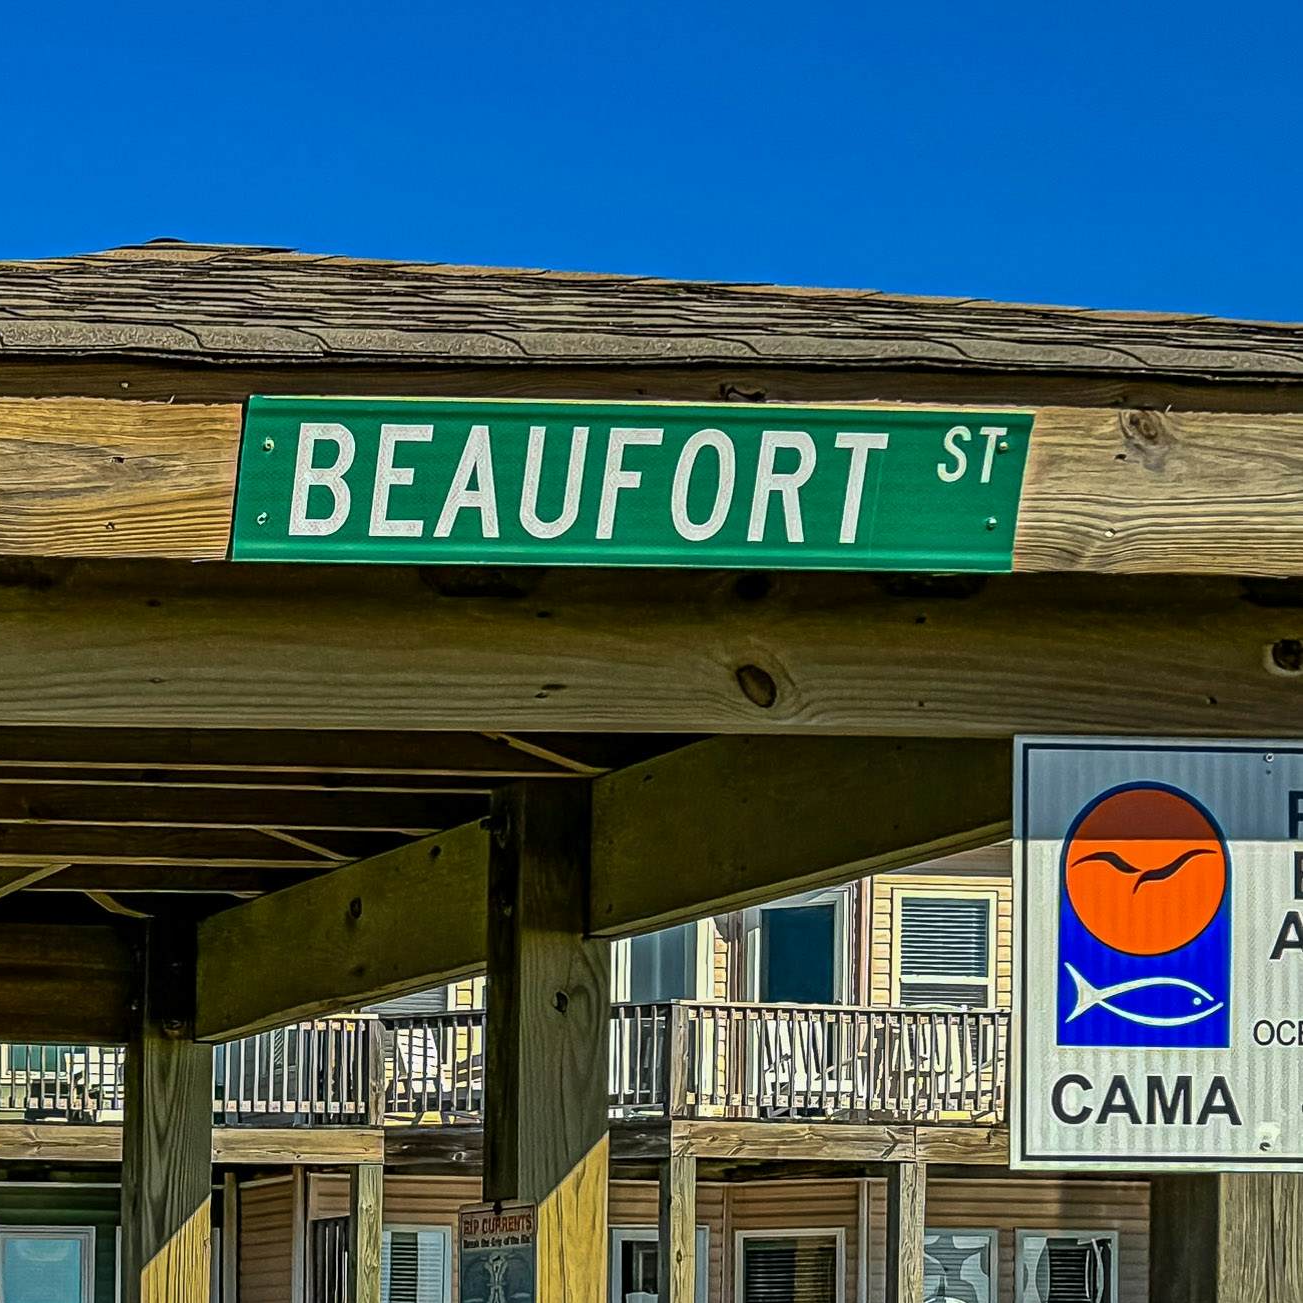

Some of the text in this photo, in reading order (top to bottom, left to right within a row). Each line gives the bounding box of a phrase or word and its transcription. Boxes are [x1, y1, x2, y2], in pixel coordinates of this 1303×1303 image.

[288, 422, 1008, 544] BEAUFORT ST
[1051, 1073, 1242, 1126] CAMA
